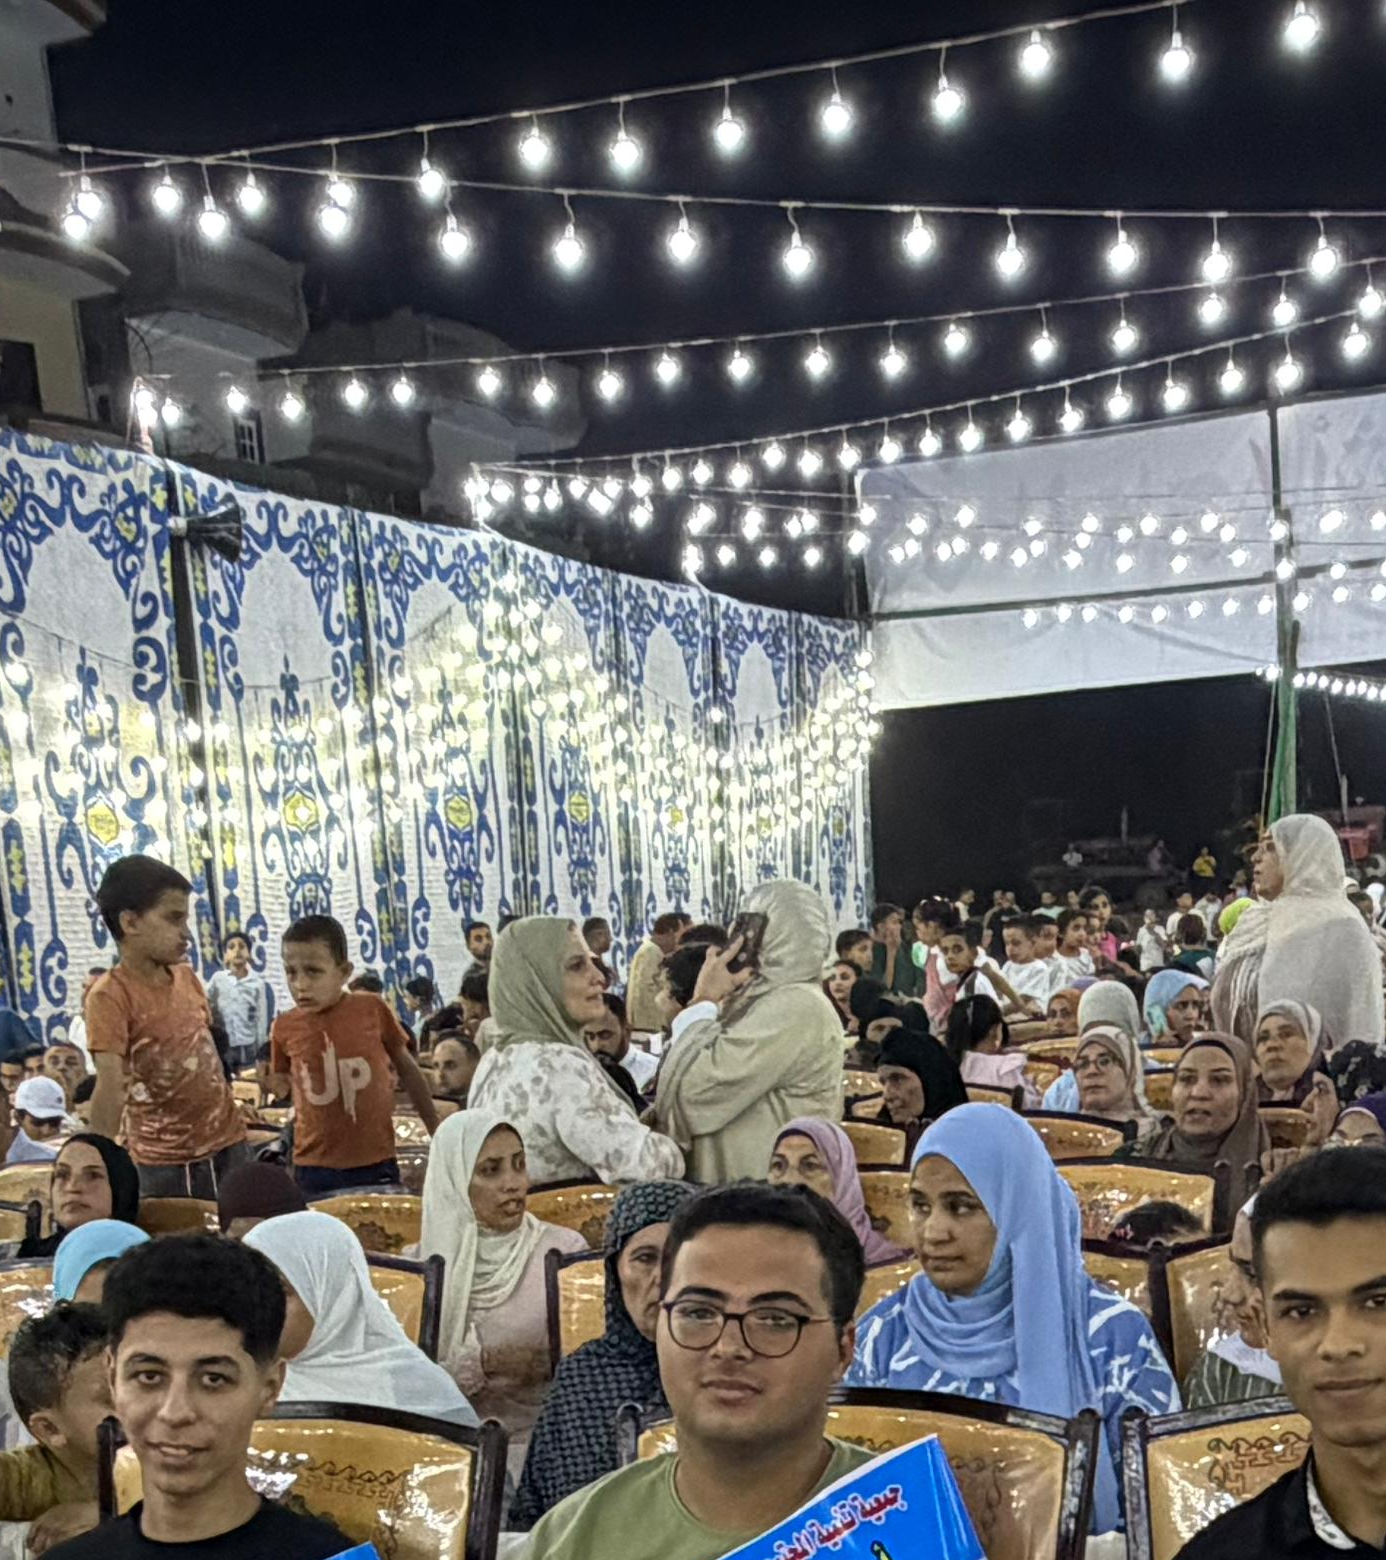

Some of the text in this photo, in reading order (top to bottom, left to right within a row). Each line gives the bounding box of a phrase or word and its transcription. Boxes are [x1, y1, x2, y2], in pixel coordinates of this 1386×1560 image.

[299, 1031, 372, 1124] UP
[806, 1502, 860, 1550] تنمية
[848, 1484, 907, 1526] جمعية
